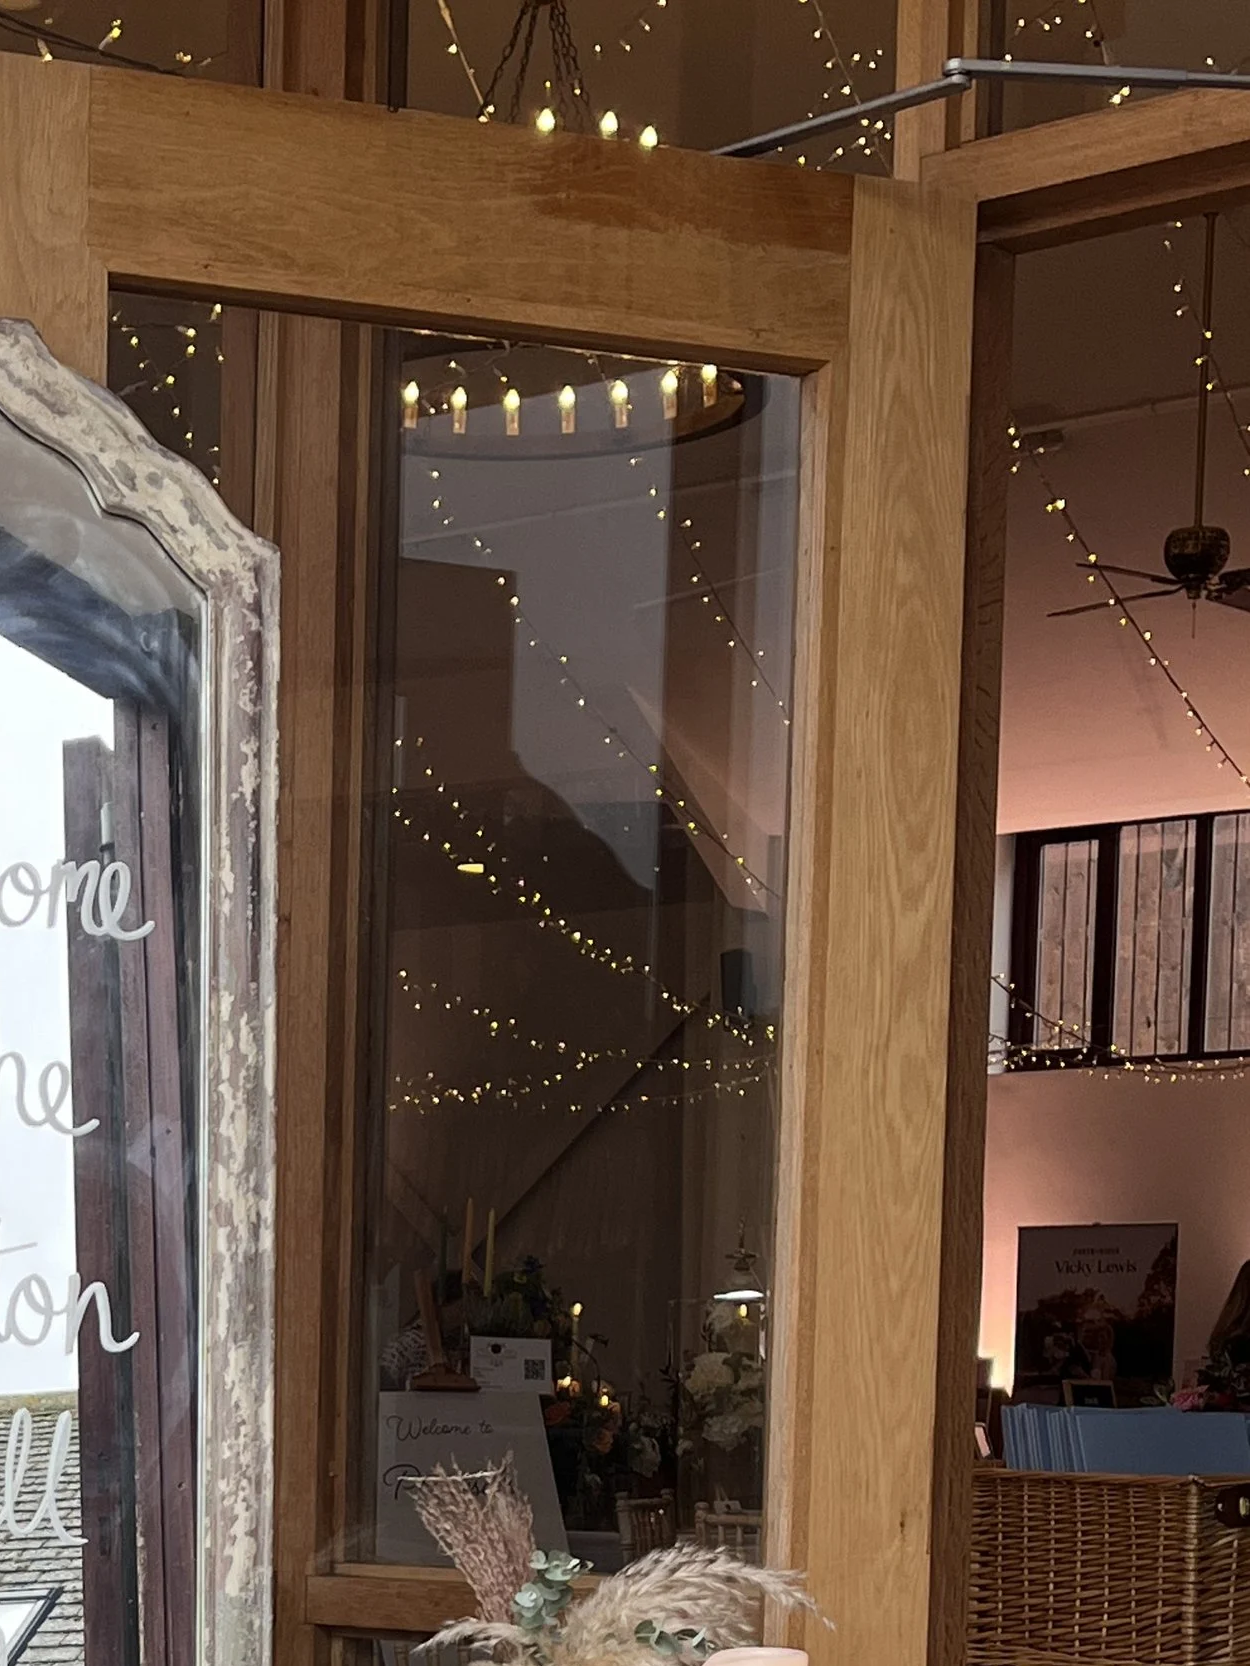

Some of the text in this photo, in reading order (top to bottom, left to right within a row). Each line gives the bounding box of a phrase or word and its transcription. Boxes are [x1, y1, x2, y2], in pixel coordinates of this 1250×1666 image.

[1055, 1258, 1138, 1277] Vicky Lewis
[386, 1415, 495, 1441] Welcome to
